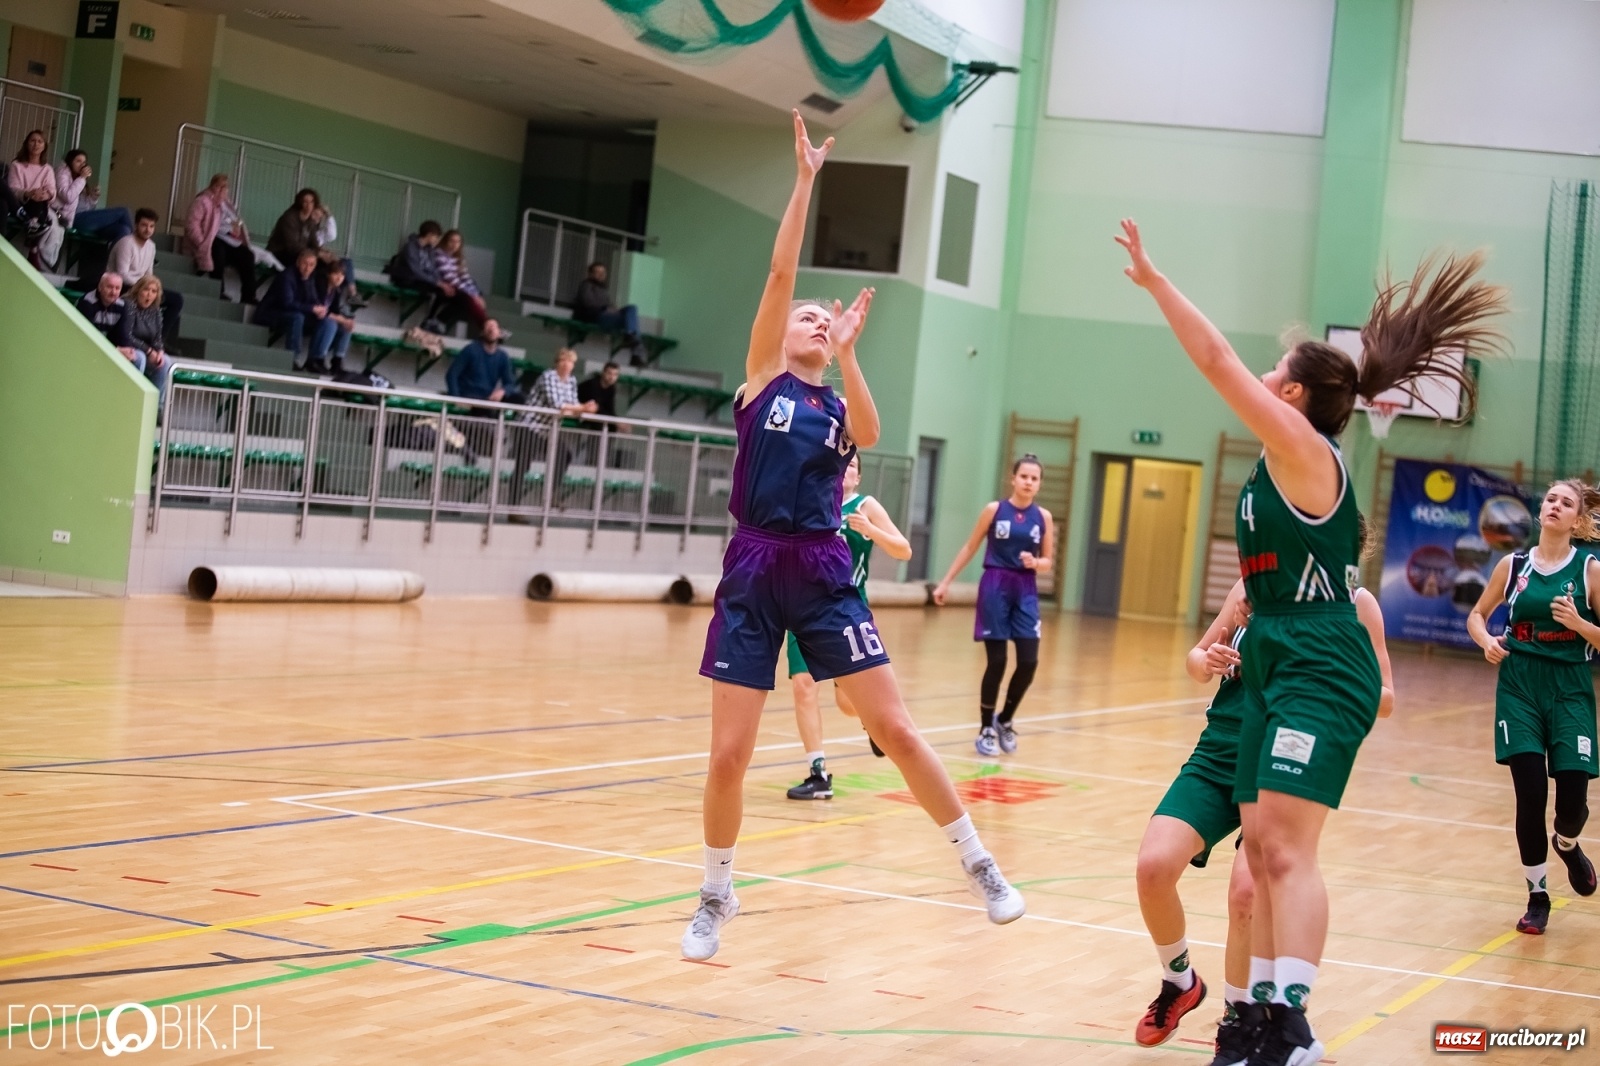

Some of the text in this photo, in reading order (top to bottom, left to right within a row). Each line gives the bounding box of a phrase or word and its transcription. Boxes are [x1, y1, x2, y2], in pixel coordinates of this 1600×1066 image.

[86, 14, 108, 34] F
[1241, 492, 1255, 532] 4
[1029, 524, 1041, 544] 4
[843, 621, 884, 662] 16
